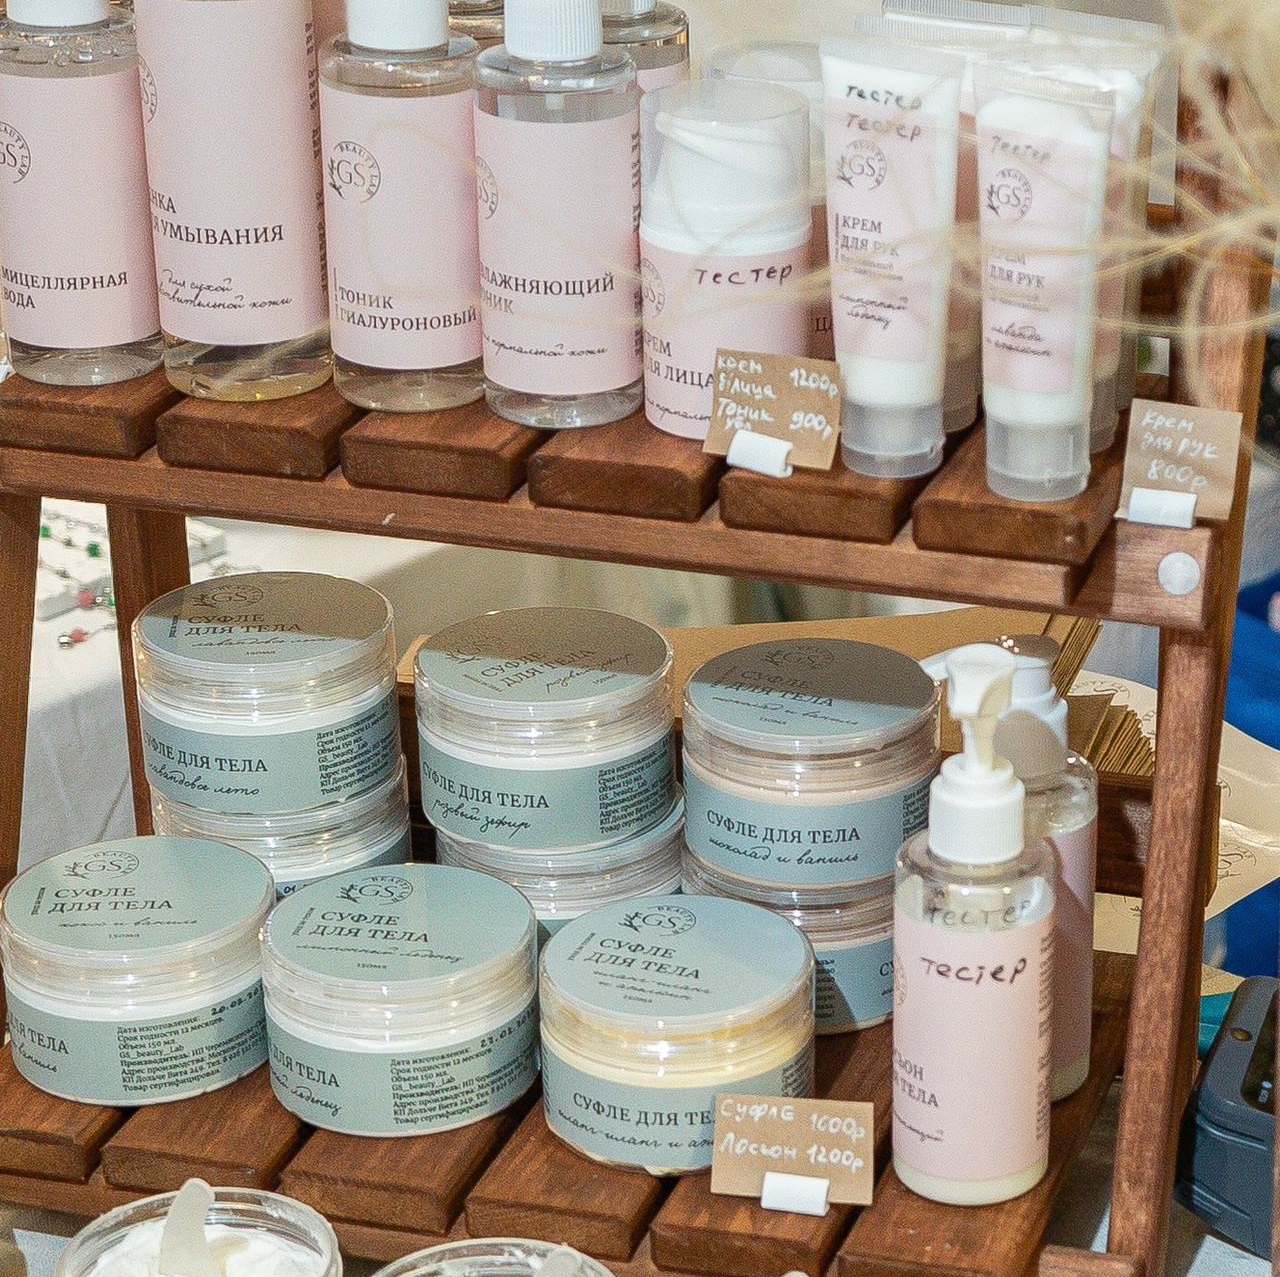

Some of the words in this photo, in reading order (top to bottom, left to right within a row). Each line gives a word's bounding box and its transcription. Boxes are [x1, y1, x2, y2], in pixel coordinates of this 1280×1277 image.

[339, 142, 376, 169] BEAUTY
[337, 159, 366, 187] GS
[150, 188, 177, 214] НКА
[160, 219, 284, 245] УМЫВАНИЯ
[842, 215, 882, 234] КРЕМ
[840, 235, 868, 251] ДЛЯ
[1, 266, 128, 291] МИЦЕЛЛЯРНАЯ
[481, 264, 615, 298] ЛАЖНЯЮЩИЙ
[695, 264, 792, 285] тестер
[3, 286, 36, 310] ВОДА
[339, 286, 394, 310] ТОНИК
[482, 288, 514, 315] НИК
[338, 305, 477, 332] ГИАЛУРОНОВЫЙ
[664, 365, 714, 389] ЛИЦА
[212, 591, 249, 603] GS
[188, 614, 265, 624] СУФЛЕ
[185, 625, 233, 636] ДЛЯ
[241, 623, 301, 633] ТЕЛА
[481, 651, 546, 678] СУФЛЕ
[777, 690, 834, 707] ТЕЛА
[177, 749, 211, 770] ДЛЯ
[215, 757, 268, 773] ТЕЛА
[214, 786, 260, 796] лето
[421, 760, 456, 795] СУФЛЕ
[458, 784, 492, 806] ДЛЯ
[497, 792, 550, 809] ТЕЛА
[706, 809, 758, 839] СУФЛЕ
[762, 827, 801, 844] ДЛЯ
[808, 826, 861, 844] ТЕЛА
[84, 859, 124, 872] GS
[54, 887, 136, 898] СУФЛЕ
[358, 884, 400, 898] GS
[48, 901, 101, 914] ДЛЯ
[108, 900, 173, 911] ТЕЛА
[321, 911, 400, 926] СУФЛЕ
[642, 913, 681, 929] GS
[309, 924, 362, 938] ДЛЯ
[367, 928, 429, 943] ТЕЛА
[599, 938, 677, 959] СУФЛЕ
[583, 951, 638, 968] ДЛЯ
[642, 960, 701, 979] ТЕЛА
[920, 957, 1027, 985] тестер
[117, 1026, 137, 1035] Дата
[117, 1034, 139, 1044] Срок
[140, 1030, 179, 1041] годности
[28, 1028, 69, 1054] ТЕЛА
[118, 1043, 146, 1051] Объем
[148, 1041, 161, 1049] 150
[121, 1067, 146, 1076] Адрес
[390, 1058, 411, 1067] Дата
[390, 1065, 412, 1075] Срок
[413, 1061, 452, 1073] годности
[122, 1076, 134, 1084] КП
[296, 1061, 340, 1087] ТЕЛА
[391, 1074, 419, 1083] Объем
[420, 1073, 433, 1081] 150
[122, 1083, 148, 1092] Товар
[900, 1077, 940, 1108] ТЕЛА
[393, 1108, 406, 1116] КП
[573, 1092, 631, 1122] СУФЛЕ
[635, 1110, 678, 1127] ДЛЯ
[684, 1110, 716, 1126] ТЕ
[394, 1116, 419, 1124] Товар
